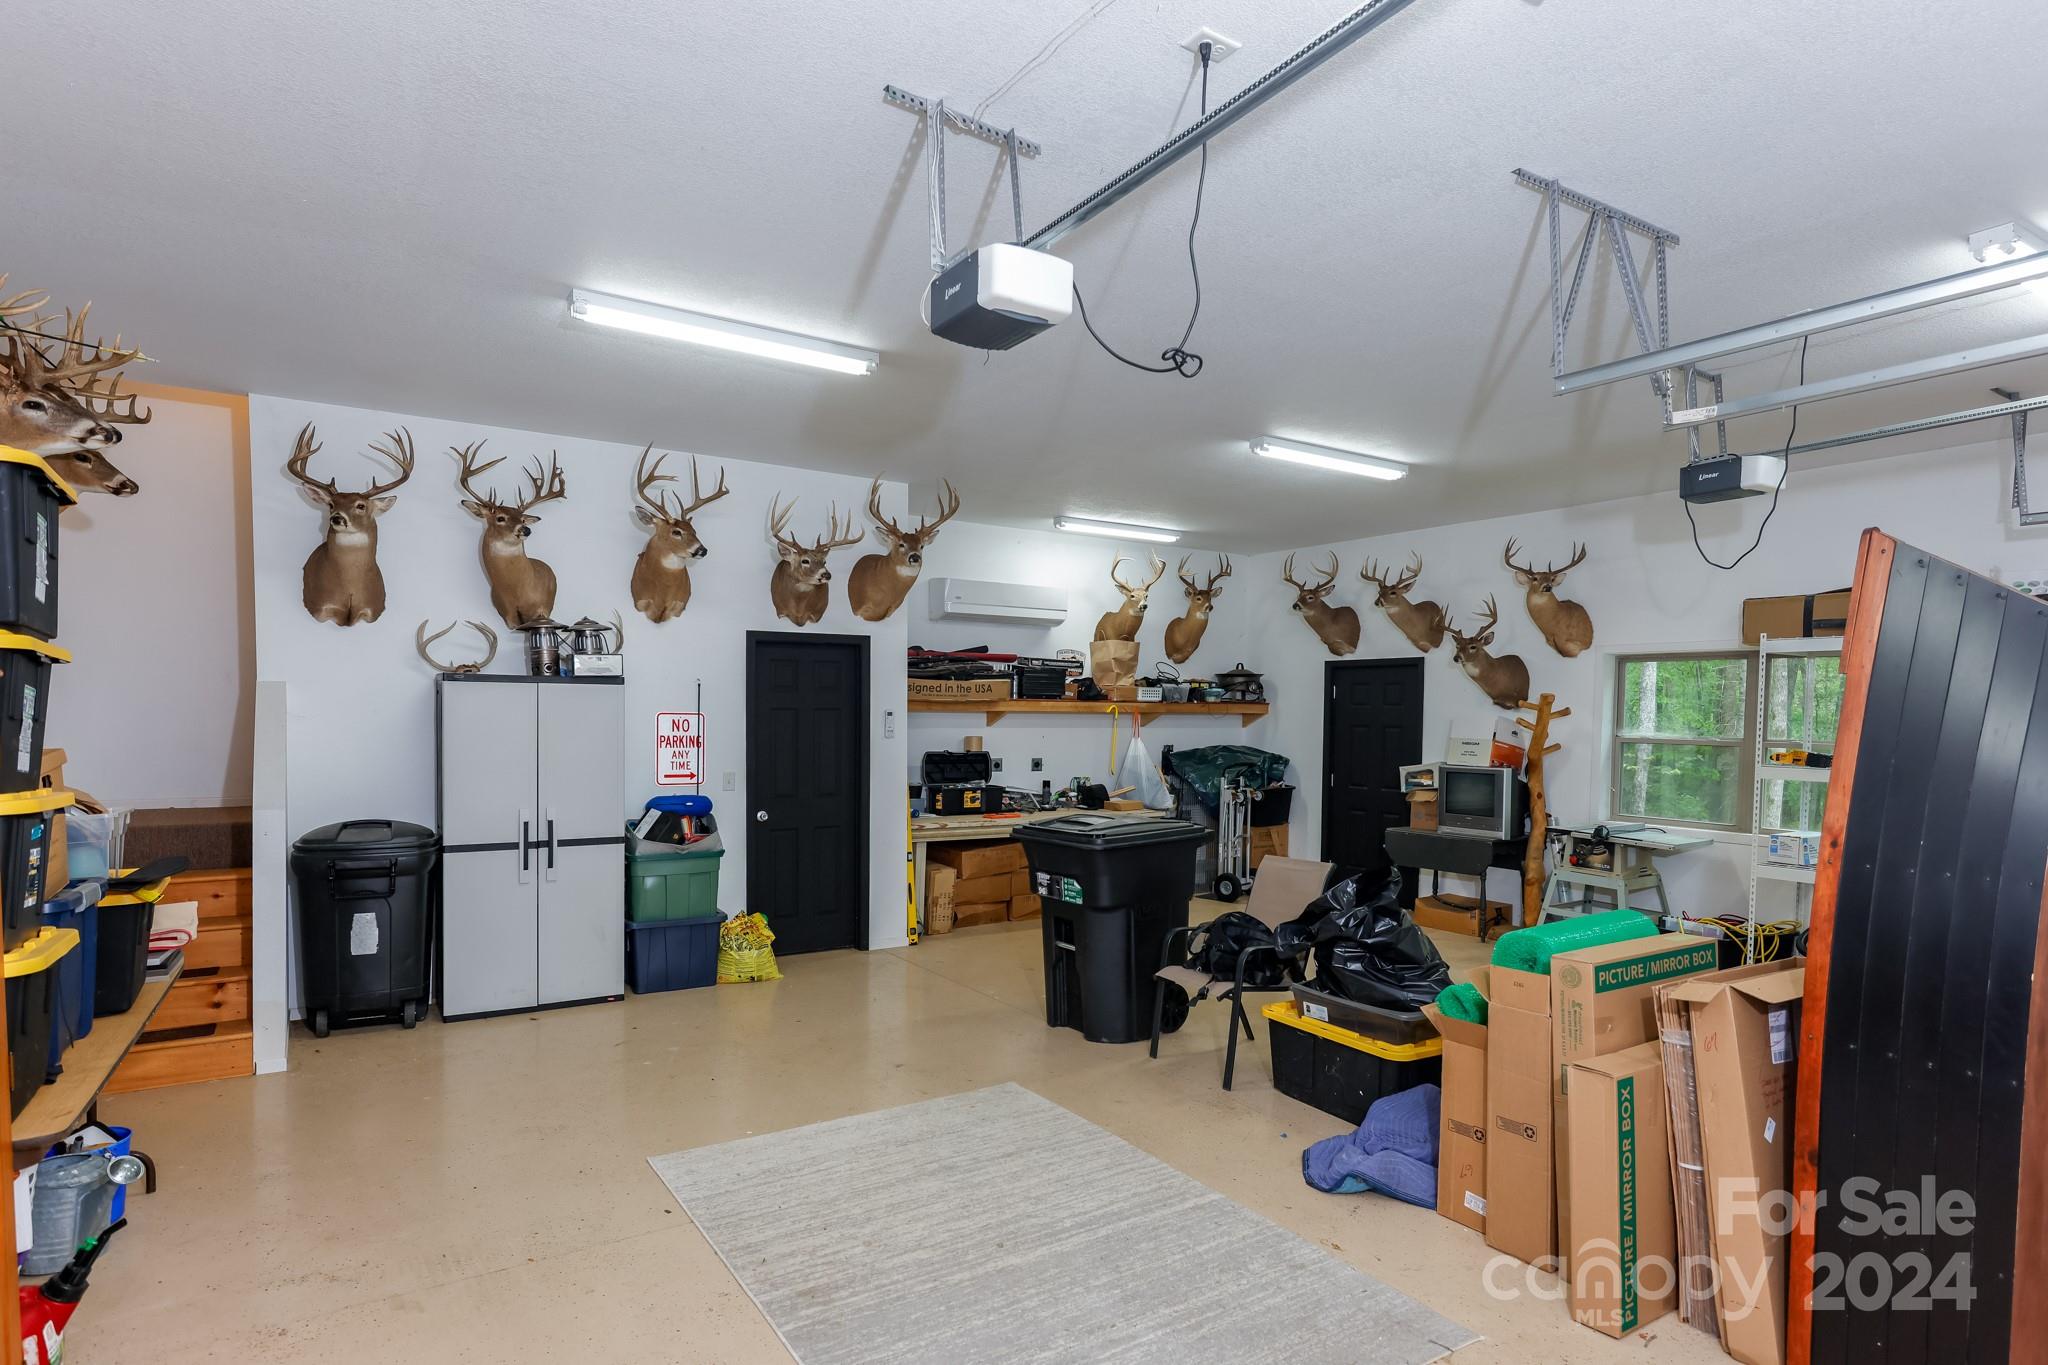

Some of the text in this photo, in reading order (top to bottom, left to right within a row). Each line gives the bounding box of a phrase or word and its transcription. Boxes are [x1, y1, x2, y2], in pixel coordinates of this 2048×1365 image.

[945, 282, 962, 301] Linear
[1698, 472, 1720, 481] Linear
[945, 683, 954, 693] in
[956, 683, 972, 693] the
[975, 684, 993, 694] USA
[671, 718, 690, 732] NO
[659, 735, 702, 749] PARKING
[671, 750, 690, 760] ANY
[670, 761, 691, 771] TIME
[1598, 963, 1644, 987] PICTURE
[1650, 956, 1690, 976] MIRROR
[1692, 949, 1713, 965] BOX
[1620, 1085, 1632, 1132] BOX
[1623, 1137, 1634, 1221] MIRROR
[1623, 1235, 1635, 1323] PICTURE
